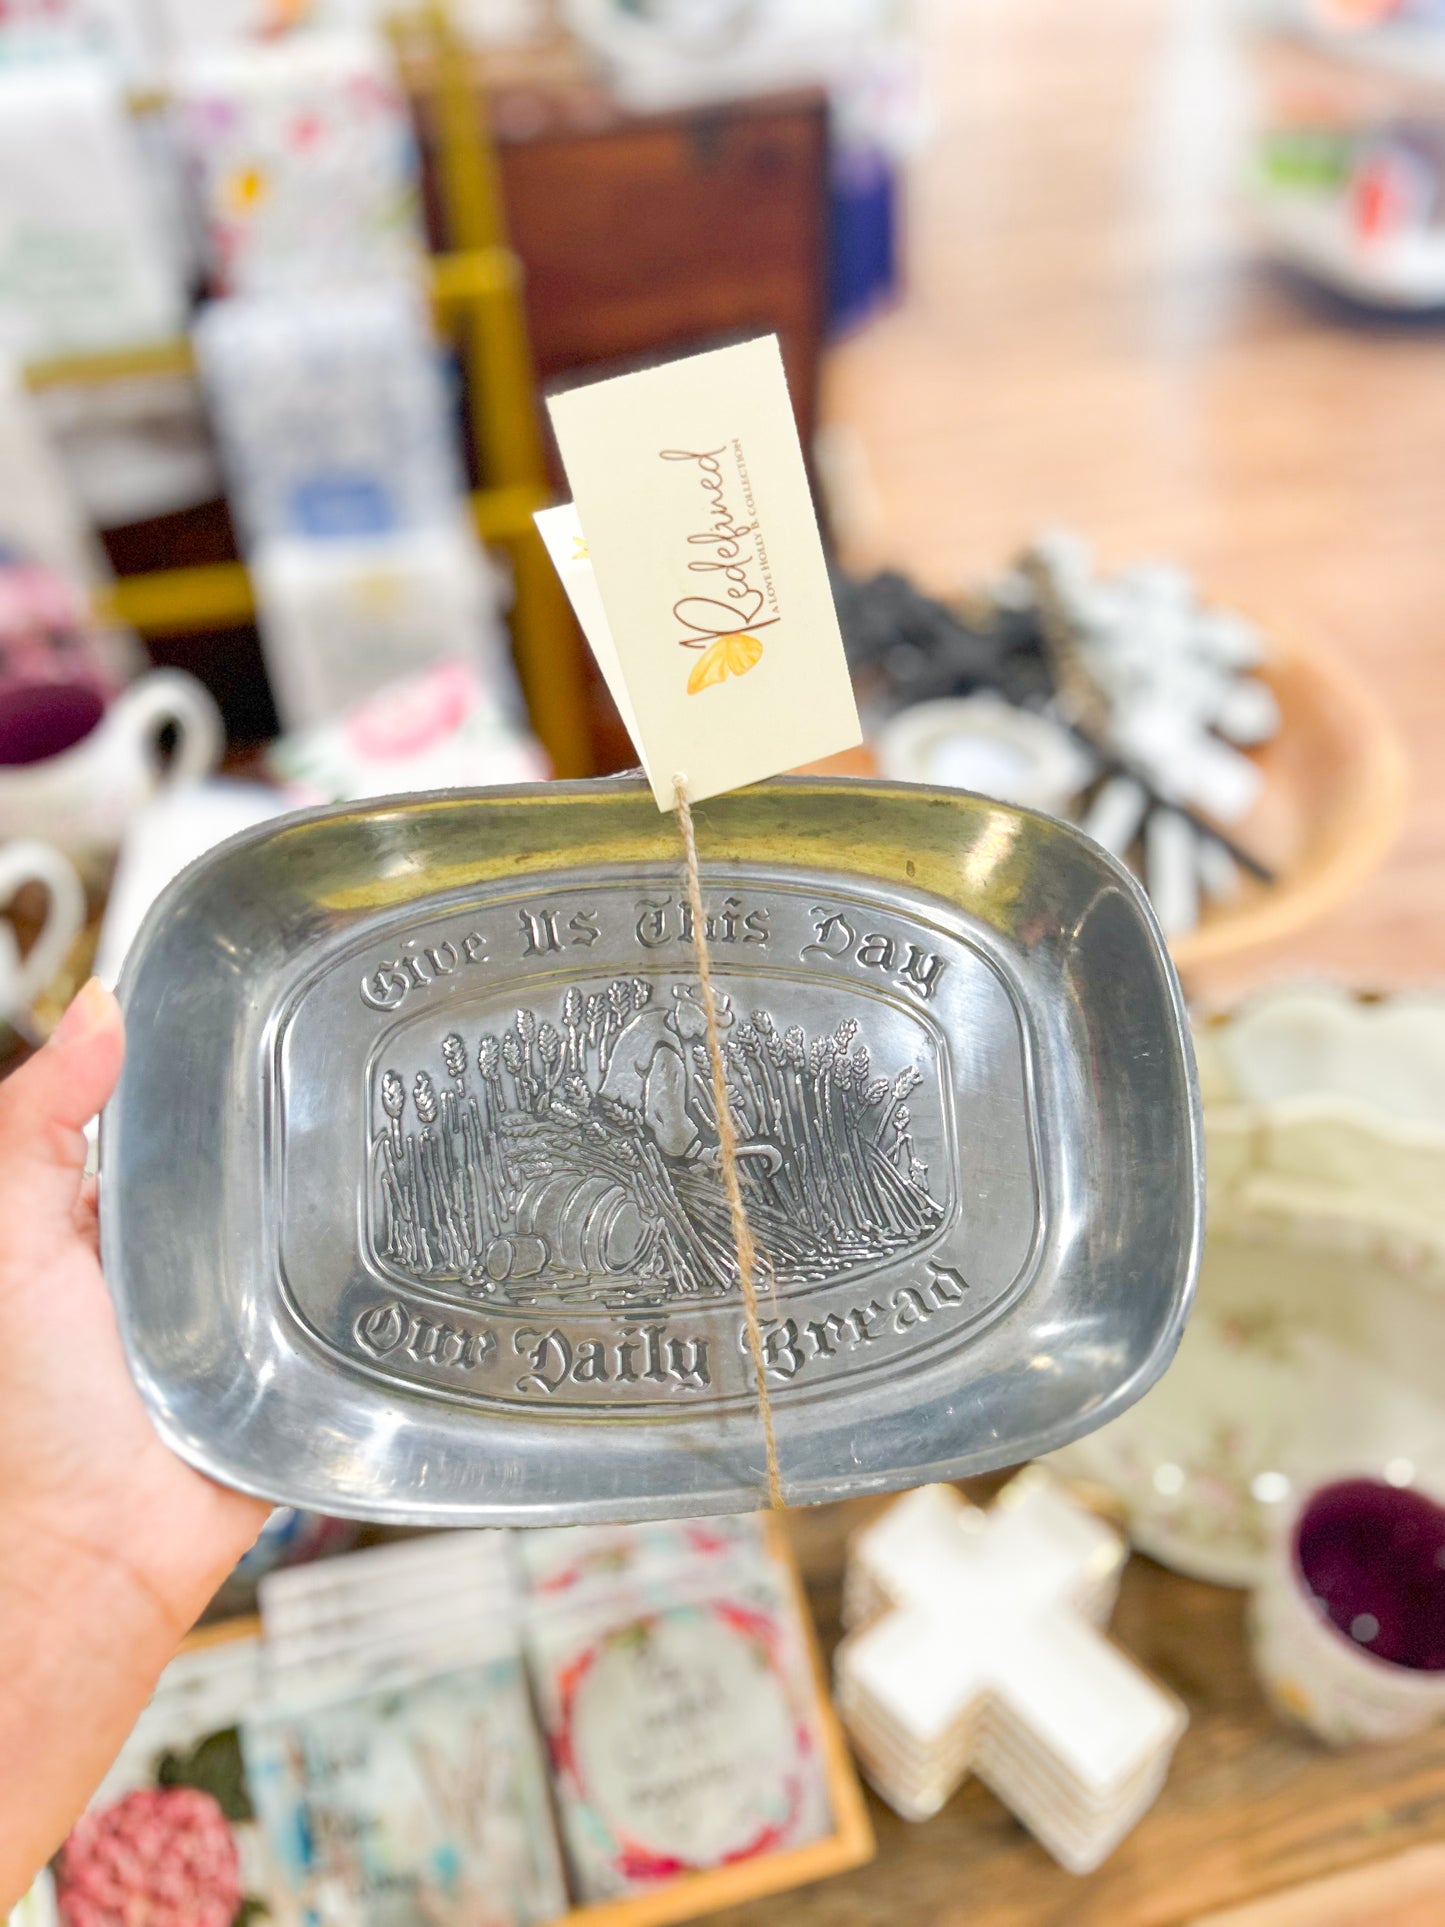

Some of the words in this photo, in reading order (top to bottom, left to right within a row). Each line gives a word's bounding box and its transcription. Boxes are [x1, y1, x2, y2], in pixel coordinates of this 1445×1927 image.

[732, 438, 757, 516] COLLECTION
[659, 444, 781, 649] Redefined
[753, 533, 770, 572] HOLLY
[359, 931, 489, 1012] Give
[518, 907, 601, 957] Us
[634, 895, 770, 948] This
[799, 904, 946, 1001] Day
[352, 1300, 497, 1369] Our
[512, 1322, 711, 1393] Daily
[740, 1257, 970, 1382] Bread
